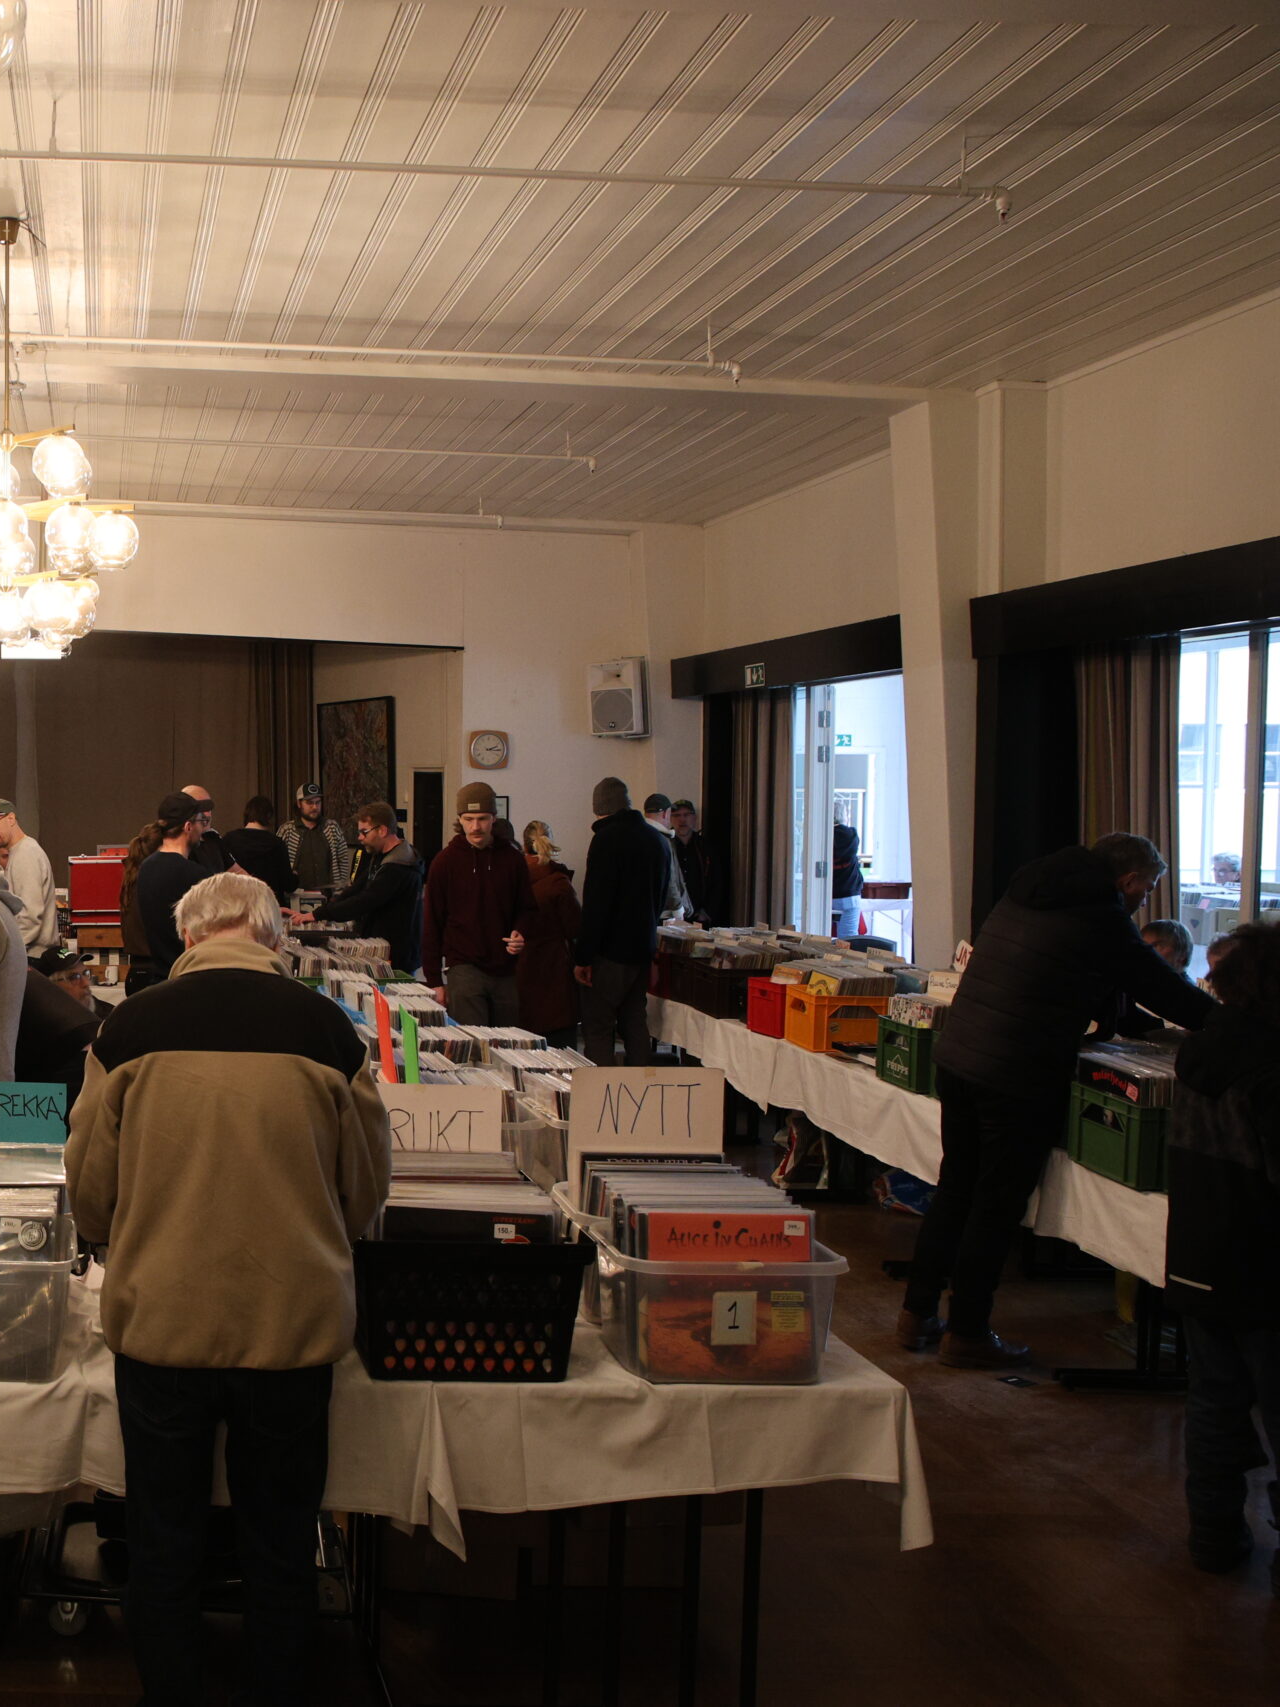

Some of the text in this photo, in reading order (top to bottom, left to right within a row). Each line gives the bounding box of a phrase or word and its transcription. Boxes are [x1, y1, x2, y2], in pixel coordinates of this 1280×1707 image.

[387, 1108, 484, 1152] RUKT
[597, 1082, 701, 1138] NYTT
[727, 1300, 740, 1330] 1
